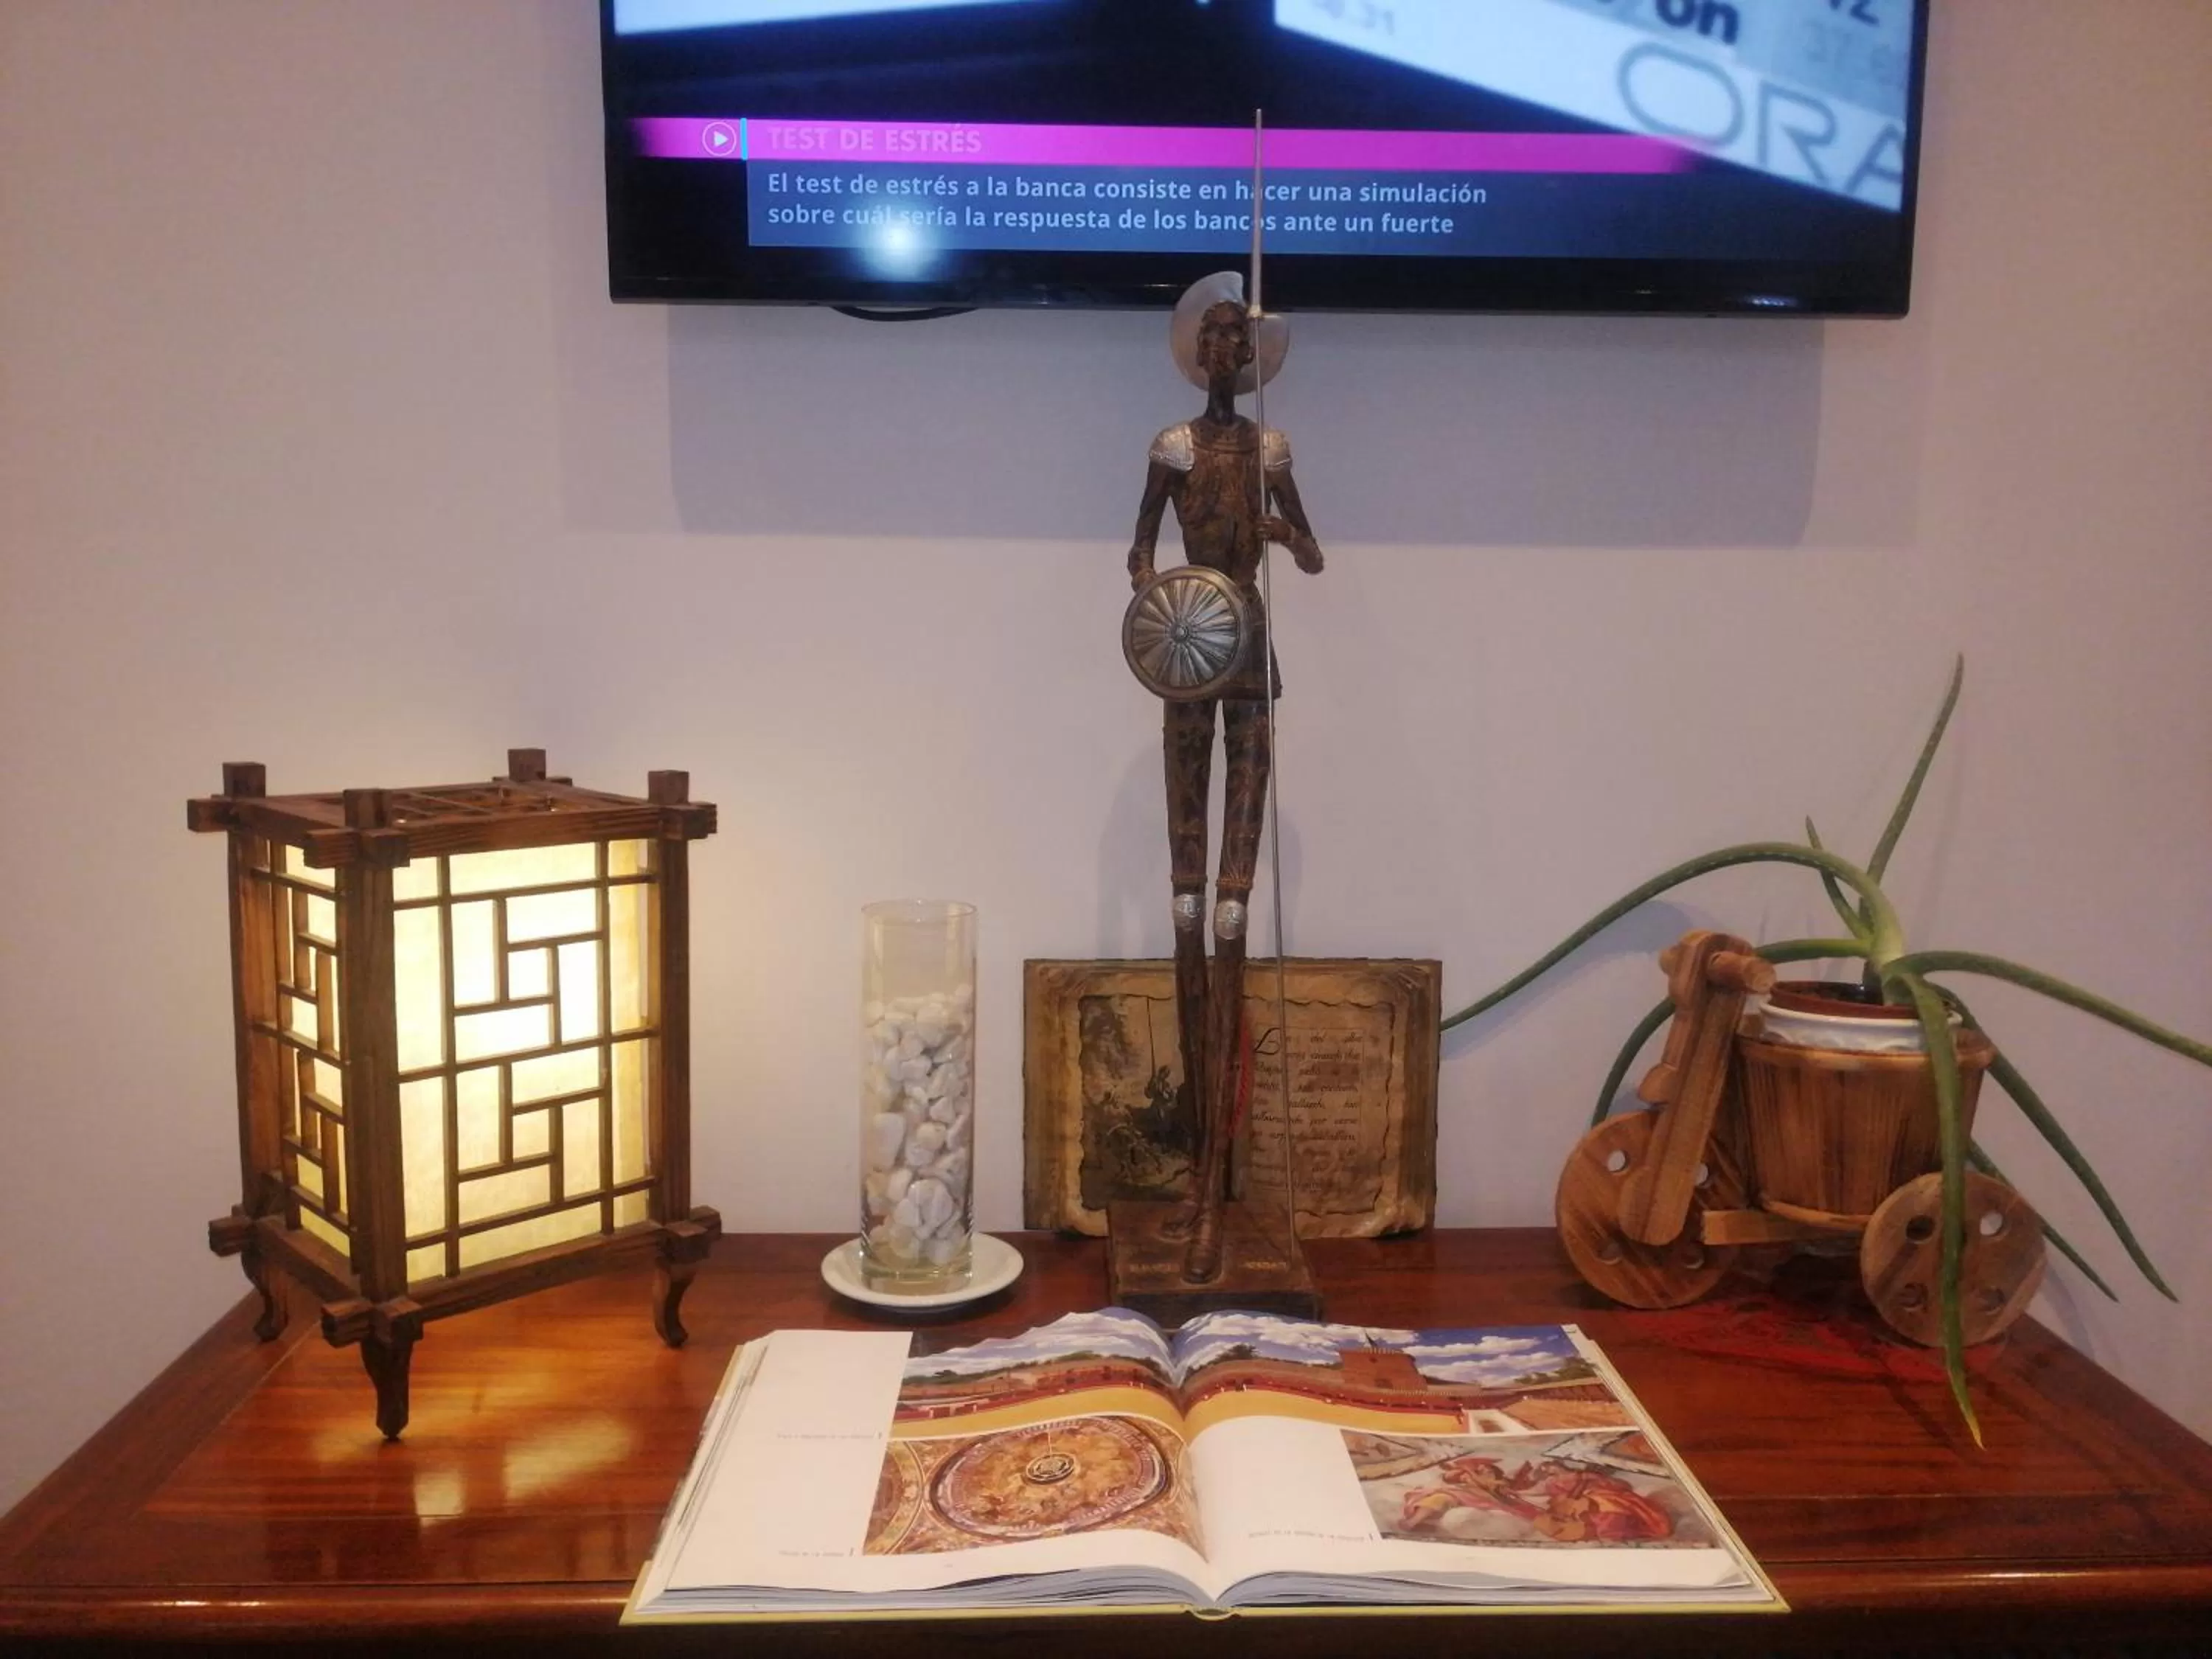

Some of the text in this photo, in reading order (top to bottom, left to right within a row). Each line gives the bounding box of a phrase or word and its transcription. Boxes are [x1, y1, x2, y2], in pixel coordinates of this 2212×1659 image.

[767, 123, 983, 153] TEST DE ESTRÉS
[768, 173, 787, 193] El
[796, 175, 844, 194] test
[850, 173, 878, 195] de
[886, 175, 959, 196] estrés
[966, 180, 980, 196] a
[987, 176, 1007, 197] la
[1016, 176, 1086, 198] banca
[1094, 178, 1192, 200] consiste
[1199, 184, 1228, 200] en
[1309, 184, 1352, 202] una
[1359, 182, 1487, 204] simulación
[768, 204, 1455, 234] sobre cuál sería la respuesta de los bancs ante un fuerte
